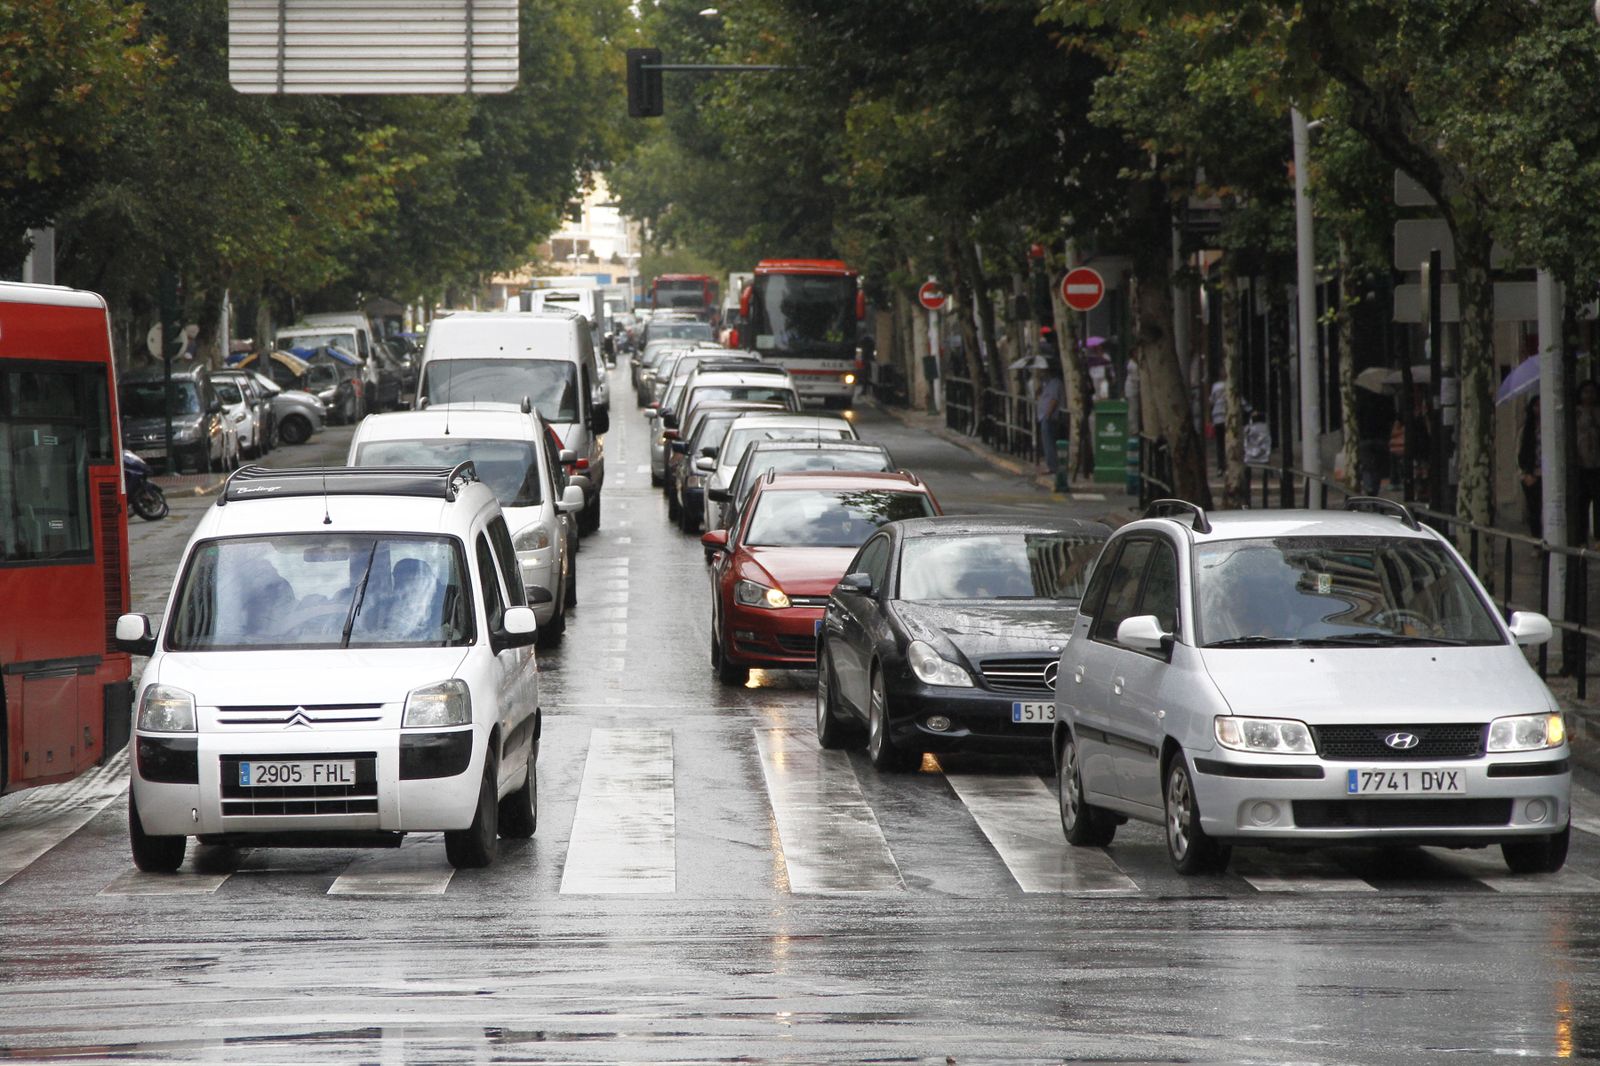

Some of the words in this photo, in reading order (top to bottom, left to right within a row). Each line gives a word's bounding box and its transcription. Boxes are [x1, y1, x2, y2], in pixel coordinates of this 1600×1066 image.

[256, 764, 303, 784] 2905
[313, 764, 351, 782] FHL
[1361, 771, 1409, 791] 7741
[1421, 771, 1458, 791] DVX
